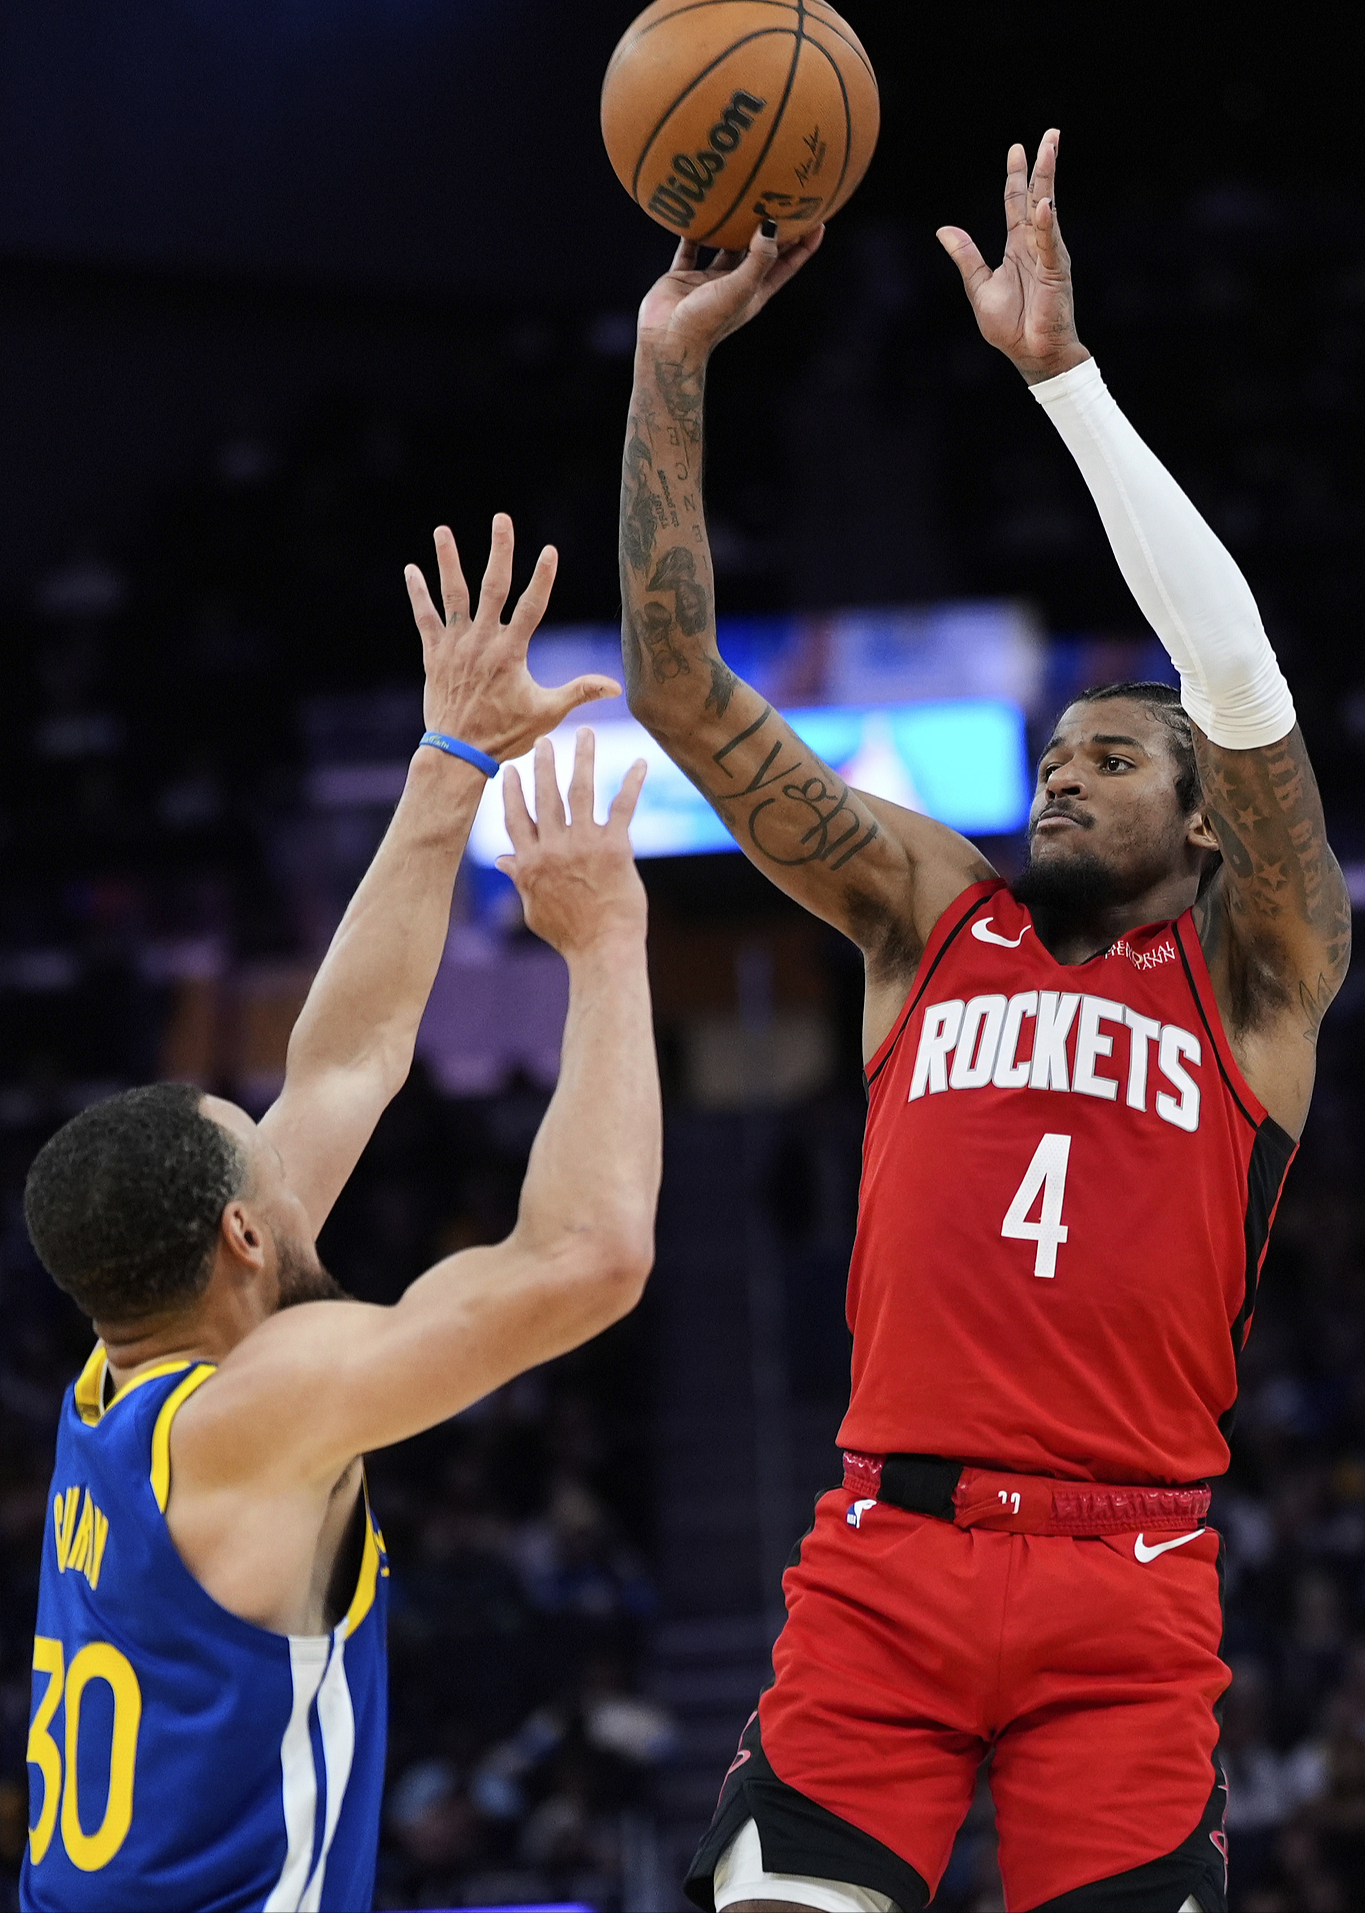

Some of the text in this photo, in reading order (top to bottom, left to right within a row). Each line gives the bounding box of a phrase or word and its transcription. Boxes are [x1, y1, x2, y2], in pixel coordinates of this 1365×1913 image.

[649, 90, 766, 228] Wilson
[907, 990, 1201, 1132] ROCKETS
[1001, 1133, 1071, 1278] 4
[26, 1635, 142, 1872] 30
